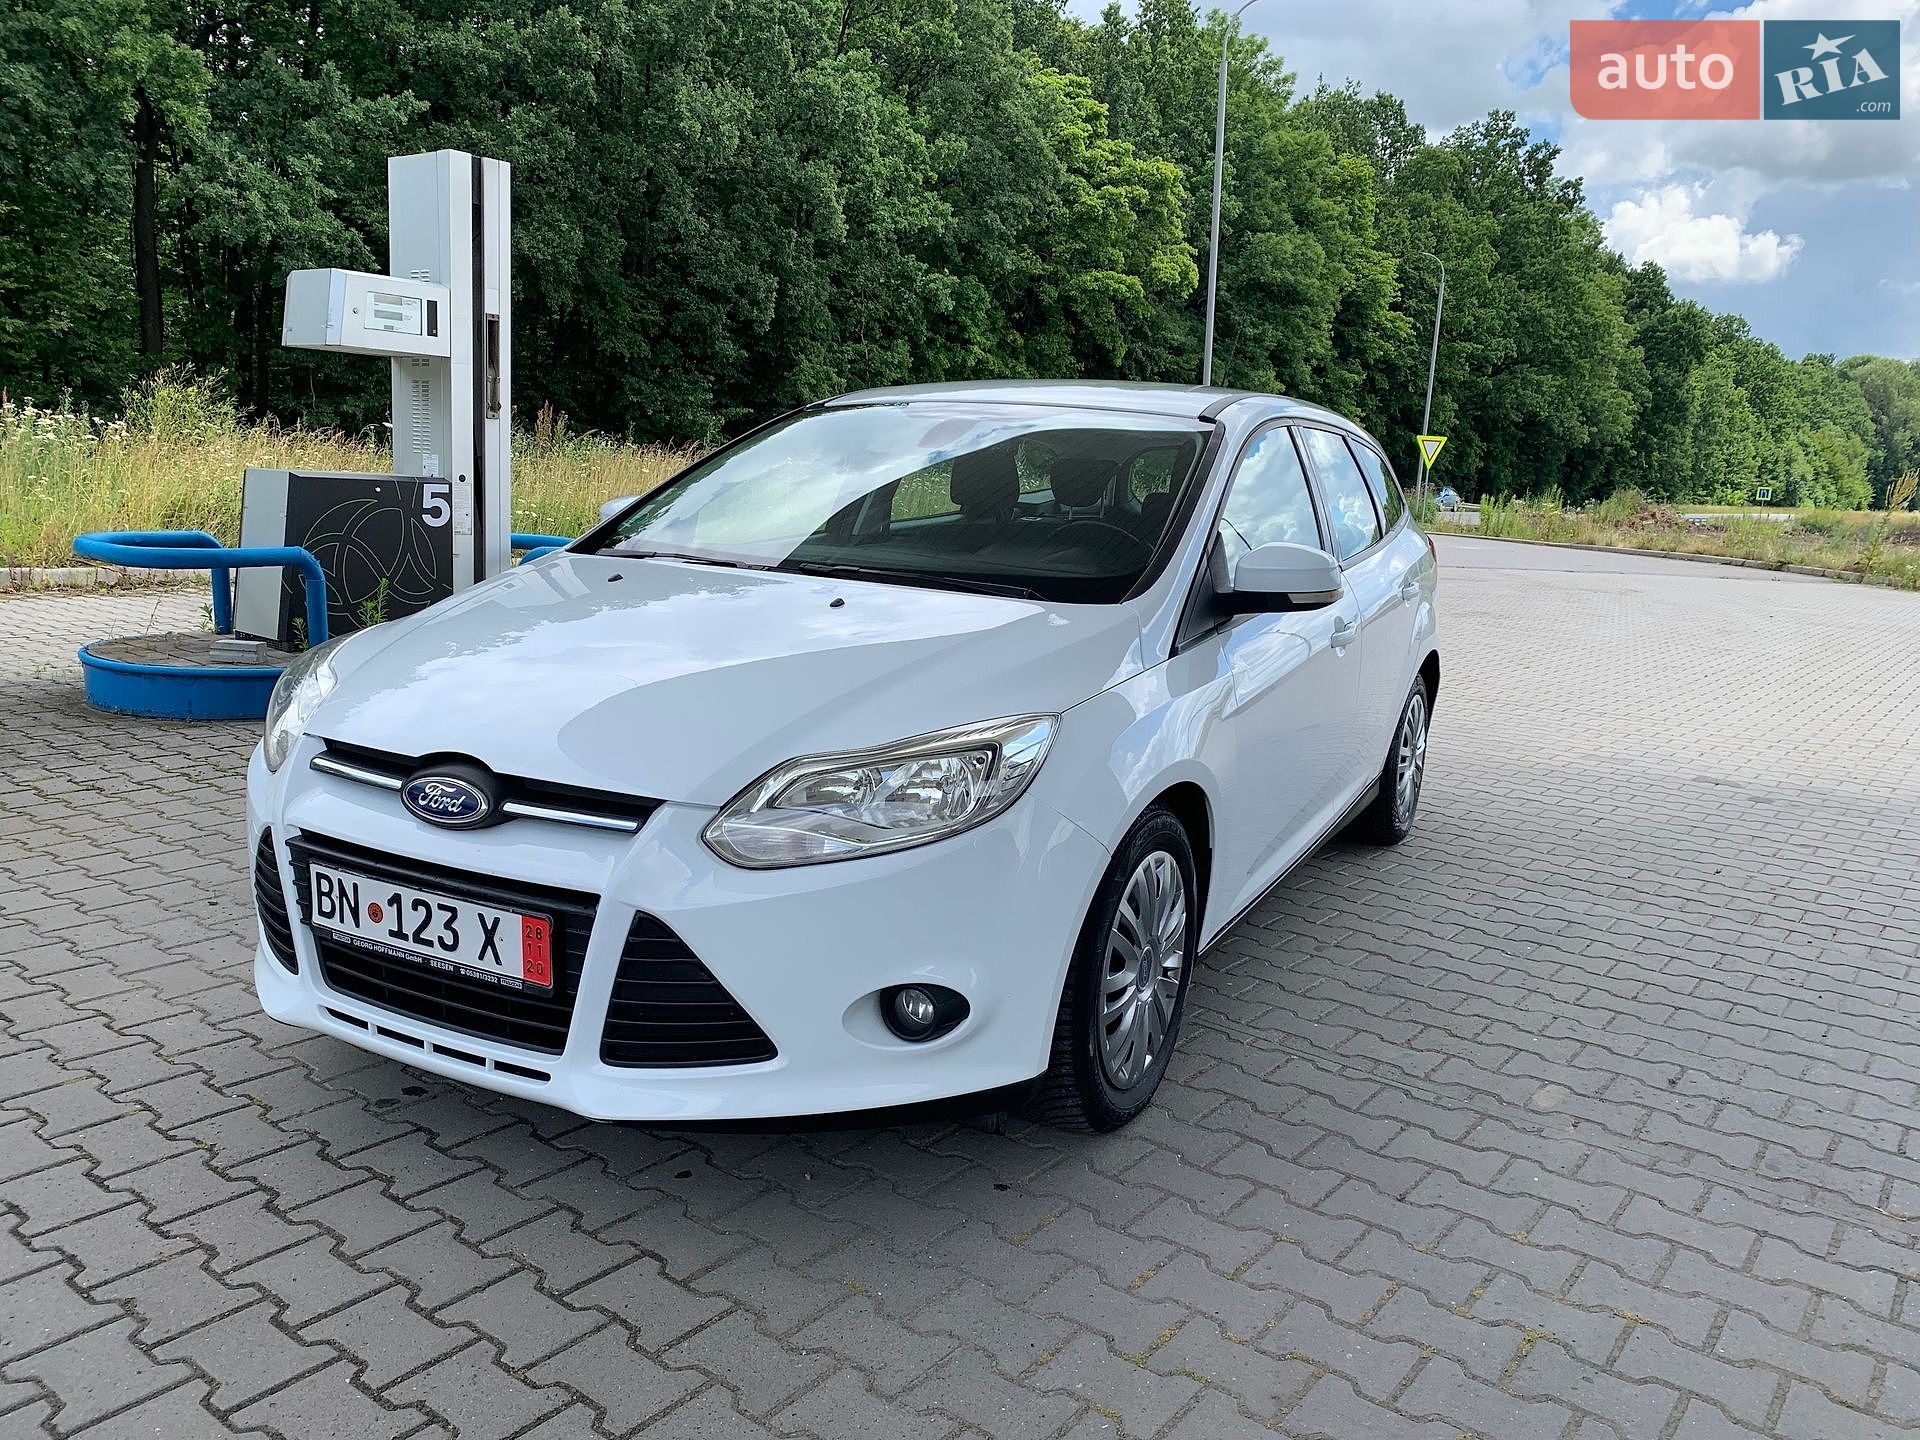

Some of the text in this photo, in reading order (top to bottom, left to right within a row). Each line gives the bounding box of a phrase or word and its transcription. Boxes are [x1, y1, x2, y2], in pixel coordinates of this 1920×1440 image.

[421, 483, 451, 527] 5
[418, 783, 466, 813] Ford
[315, 871, 503, 966] BN 123 X
[525, 924, 543, 941] 28
[353, 939, 373, 950] GEORG
[373, 945, 404, 959] HOFFMANN
[405, 953, 423, 964] GmbH
[429, 959, 454, 972] SEESEN
[527, 942, 543, 958] 11
[526, 959, 544, 976] 20
